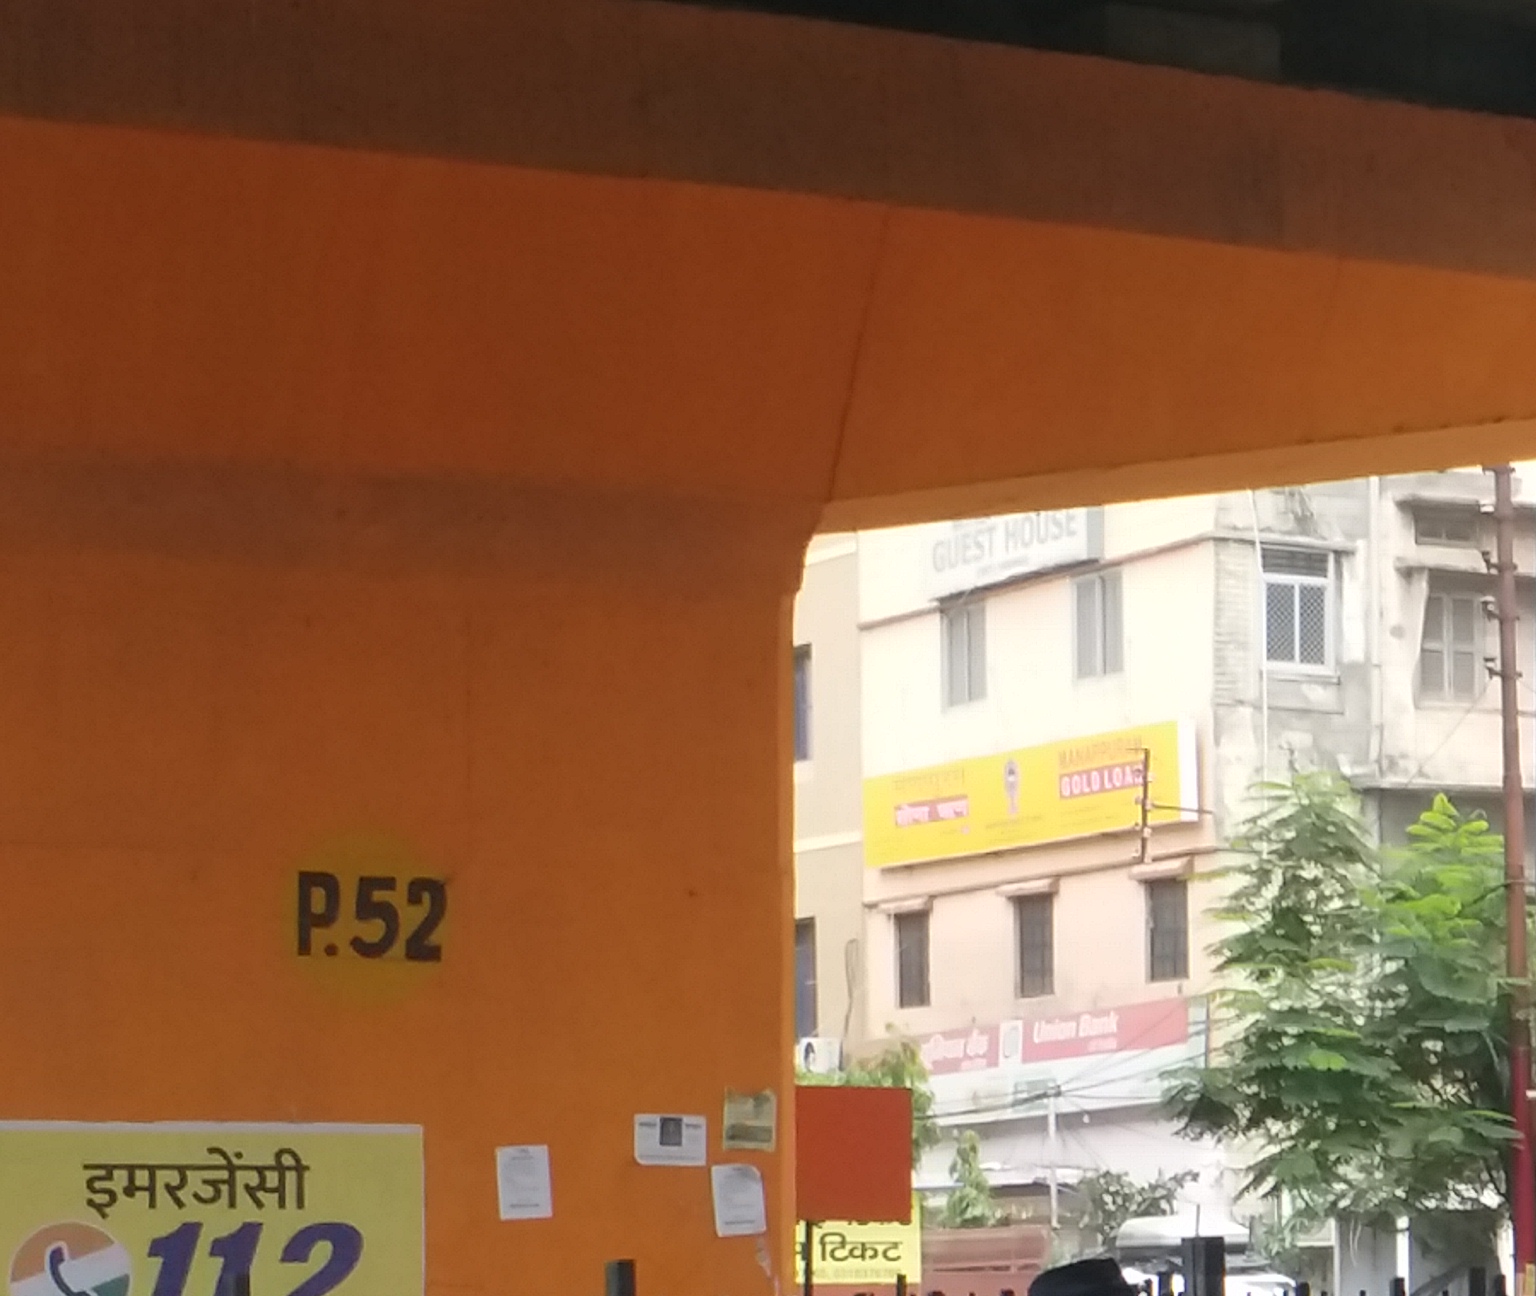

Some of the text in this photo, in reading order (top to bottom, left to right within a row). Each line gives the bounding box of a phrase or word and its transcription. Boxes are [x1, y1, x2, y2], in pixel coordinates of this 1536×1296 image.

[932, 526, 996, 572] GUEST
[1004, 511, 1077, 554] HOUSE
[1060, 770, 1101, 797] GOLD
[298, 871, 448, 963] P.52
[1033, 1010, 1119, 1043] Union Bank
[83, 1147, 311, 1219] इमरजेंसी
[819, 1232, 903, 1262] टिकट
